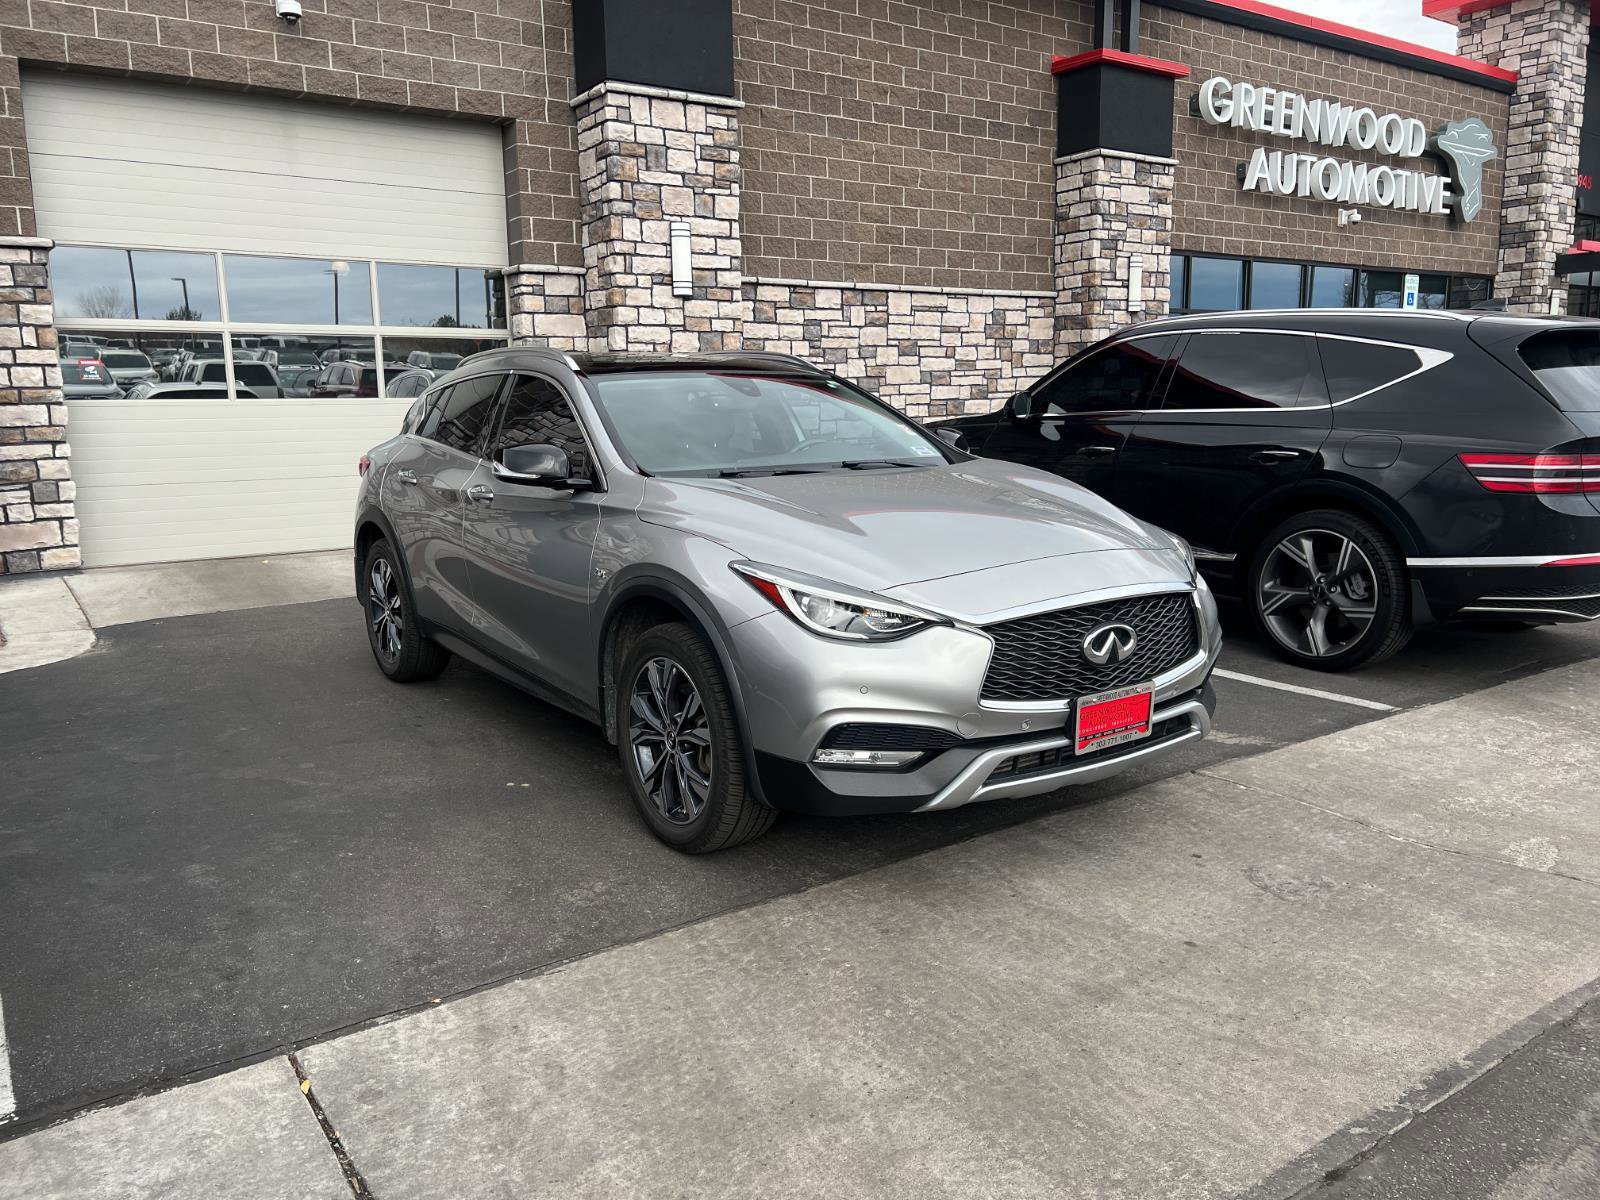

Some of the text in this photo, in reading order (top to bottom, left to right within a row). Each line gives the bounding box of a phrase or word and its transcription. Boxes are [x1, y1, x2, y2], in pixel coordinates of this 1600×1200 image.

[1199, 76, 1426, 158] GREENWOOD
[1242, 147, 1452, 214] AUTOMOTIVE
[1080, 703, 1127, 720] GREENWOOD
[1088, 711, 1133, 727] AUTOMOTIVE
